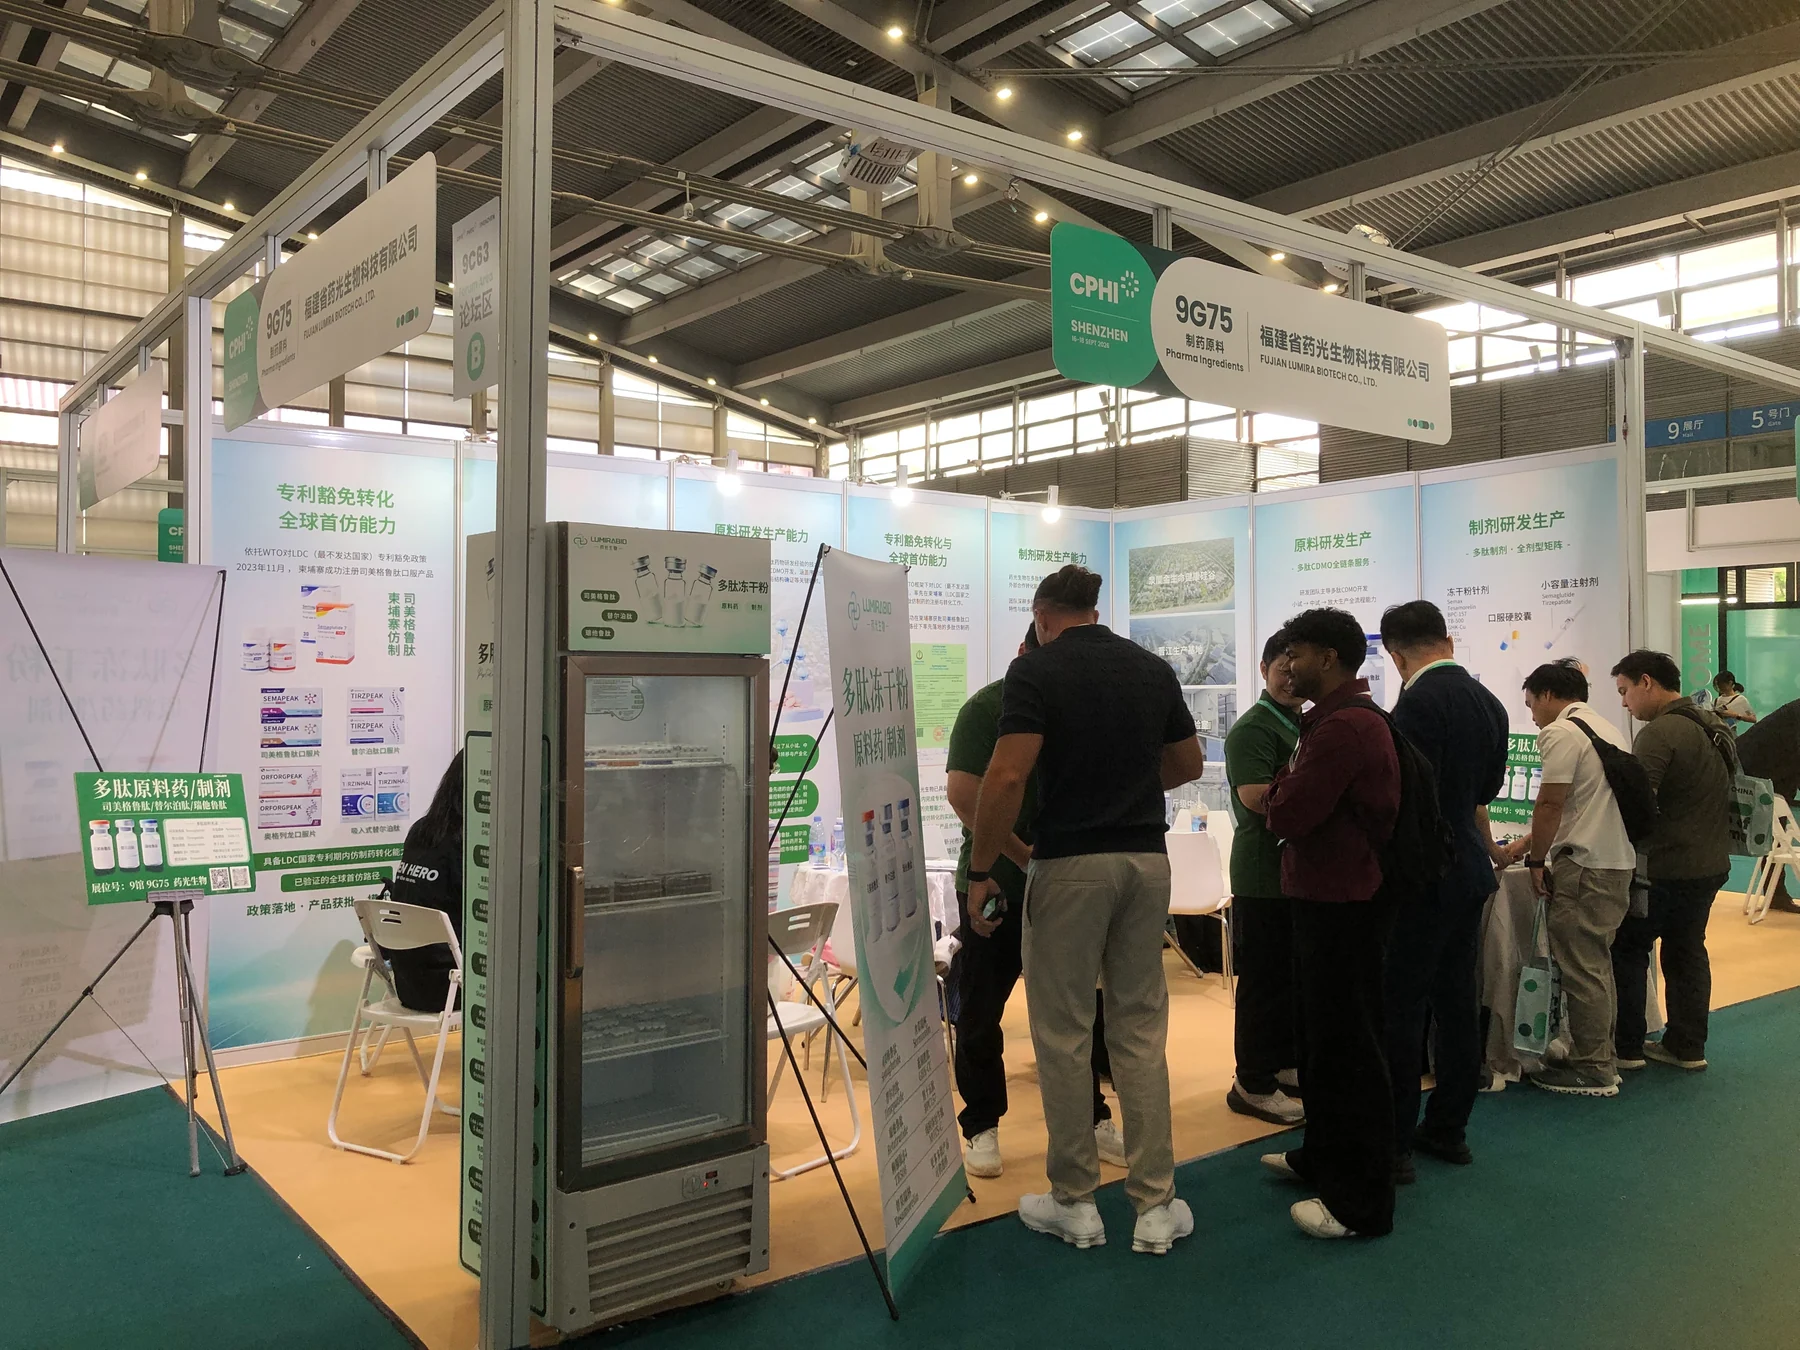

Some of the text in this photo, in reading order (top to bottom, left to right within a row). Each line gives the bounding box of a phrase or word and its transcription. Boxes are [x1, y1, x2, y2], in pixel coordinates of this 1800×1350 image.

[463, 241, 489, 274] 9C63
[304, 225, 417, 321] 福建省药光生物科技有限公司
[1069, 272, 1119, 304] CPHI
[267, 299, 291, 339] 9G75
[303, 324, 318, 340] FUJIAN
[319, 314, 334, 332] LUMIRA
[335, 303, 354, 322] BIOTECH
[365, 289, 376, 304] LTD.
[459, 288, 492, 329] 论坛区
[1175, 295, 1233, 334] 9G75
[1071, 319, 1128, 343] SHENZHEN
[229, 336, 246, 359] CPHI
[1185, 333, 1225, 354] 制药原料
[1260, 325, 1430, 382] 福建省药光生物科技有限公司
[471, 339, 481, 371] B
[1166, 348, 1244, 372] Pharma Ingredients
[1260, 354, 1287, 369] FUJIAN
[1288, 361, 1316, 375] LUMIRA
[1316, 367, 1347, 381] BIOTECH
[1363, 377, 1378, 388] LTD.
[1751, 407, 1790, 428] 5 号门
[1667, 419, 1704, 440] 9 展厅
[276, 483, 394, 509] 专利豁免转化
[278, 510, 396, 535] 全球首仿能力
[714, 523, 808, 544] 原料研发生产能力
[1468, 510, 1566, 536] 制剂研发生产
[884, 532, 952, 550] 专利豁免转化与
[1294, 531, 1372, 552] 原料研发生产
[888, 551, 947, 568] 全球首仿能力
[1018, 547, 1087, 565] 制剂研发生产能力
[717, 579, 768, 594] 多肽冻干粉
[1447, 585, 1489, 597] 冻干粉针剂
[1541, 576, 1599, 590] 小容量注射剂
[721, 602, 739, 610] 原料药
[1542, 591, 1575, 599] Semaglutide
[388, 592, 401, 657] 柬埔寨仿制
[403, 592, 416, 657] 司美格鲁肽
[1488, 611, 1532, 623] 口服硬胶囊
[842, 667, 909, 717] 多肽冻干粉
[93, 778, 231, 800] 多肽原料药/制剂
[102, 800, 227, 812] 司美格鲁肽/替尔泊肽/瑞他鲁肽
[146, 879, 170, 889] 9G75
[173, 876, 207, 887] 药光生物
[294, 871, 380, 887] 已验证的全球首仿路径
[407, 864, 439, 881] HERO
